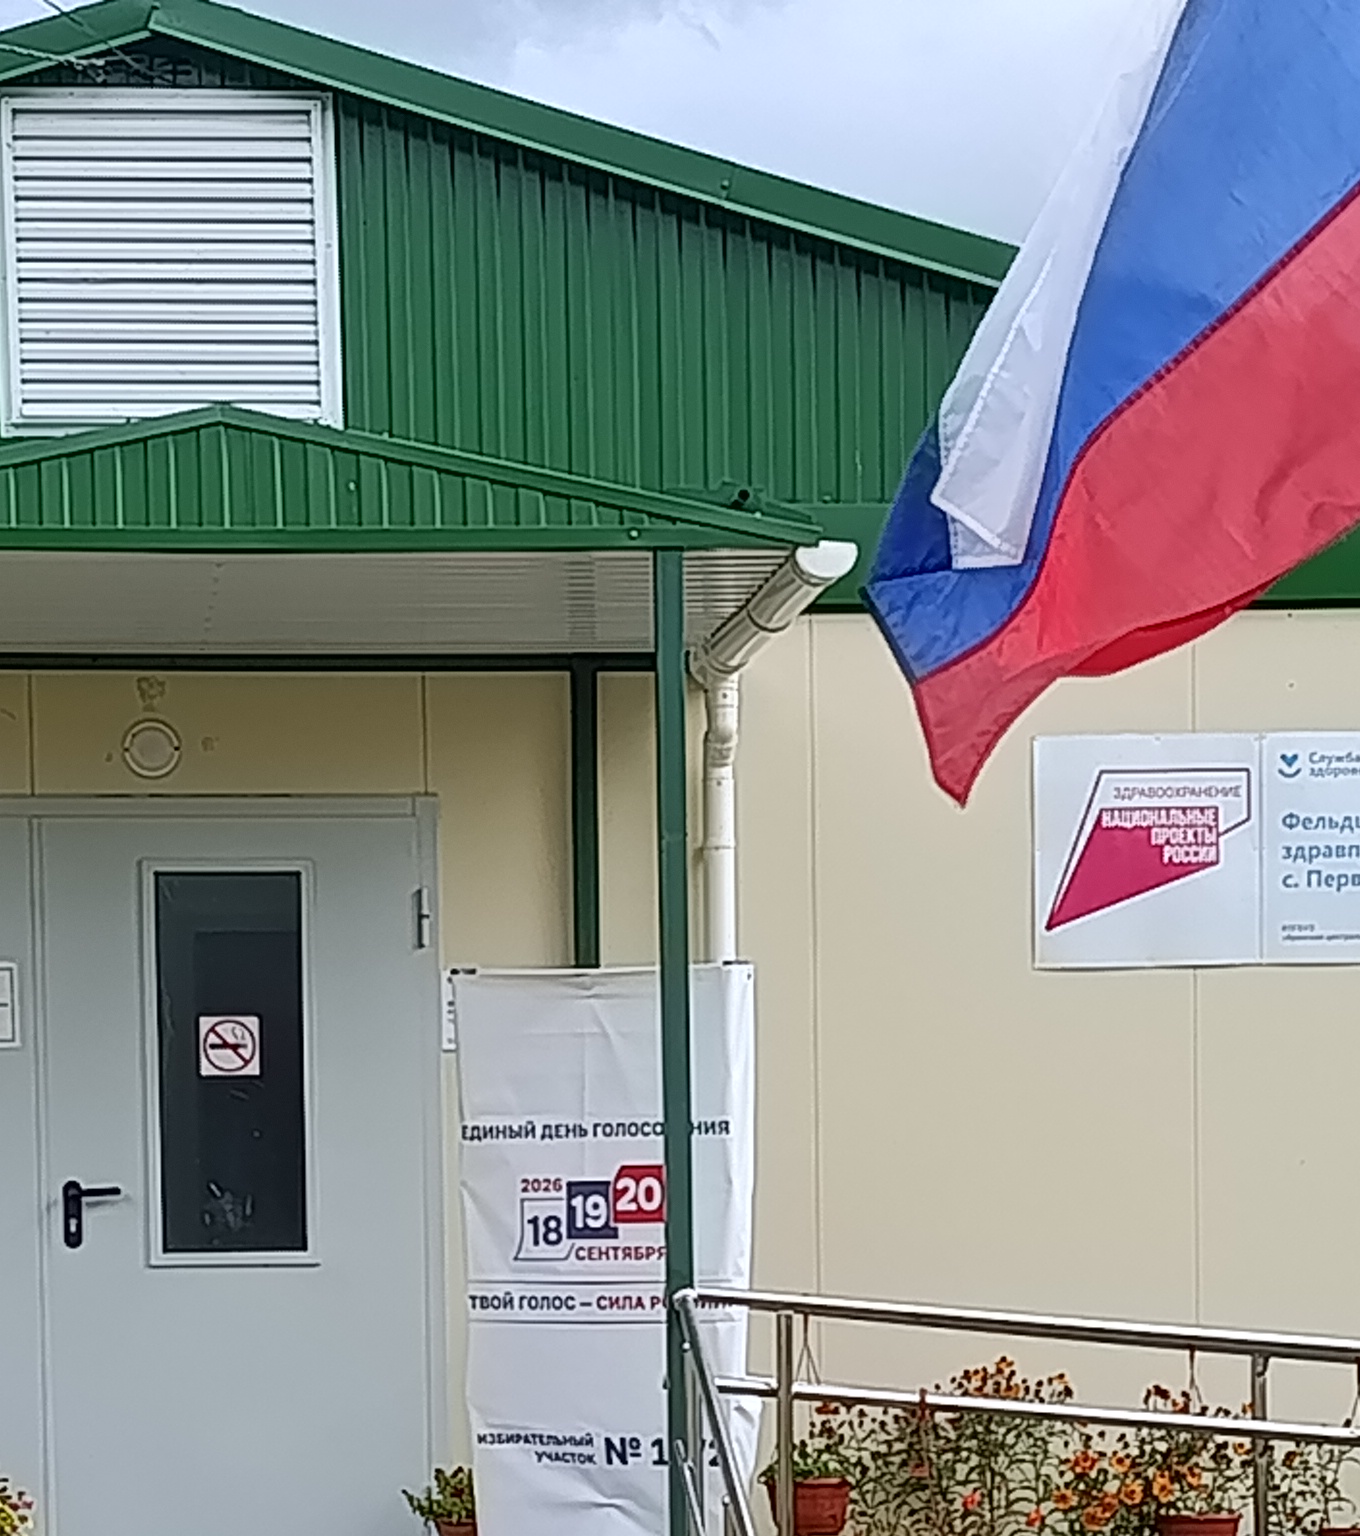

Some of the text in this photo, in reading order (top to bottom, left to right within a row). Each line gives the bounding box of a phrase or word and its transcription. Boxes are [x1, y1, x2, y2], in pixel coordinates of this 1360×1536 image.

[1113, 785, 1242, 800] ЗДРАВООХРАНЕНИЕ
[1102, 809, 1217, 828] НАЦИОНАЛЬНЫЕ
[1151, 827, 1217, 846] ПРОЕКТЫ
[1163, 845, 1217, 863] РОССИИ
[1281, 874, 1300, 889] с.
[461, 1120, 731, 1142] ЕДИНЫЙ ДЕНЬ ГОЛОСОНИЯ
[520, 1178, 563, 1193] 2026
[527, 1176, 663, 1247] 18 19 20
[469, 1291, 515, 1310] ТВОЙ
[519, 1295, 576, 1310] ГОЛОС
[596, 1295, 644, 1311] СИЛА
[477, 1433, 594, 1446] ИЗБИРАТЕЛЬНЫЙ
[535, 1451, 598, 1465] УЧАСТОК
[604, 1437, 642, 1466] №
